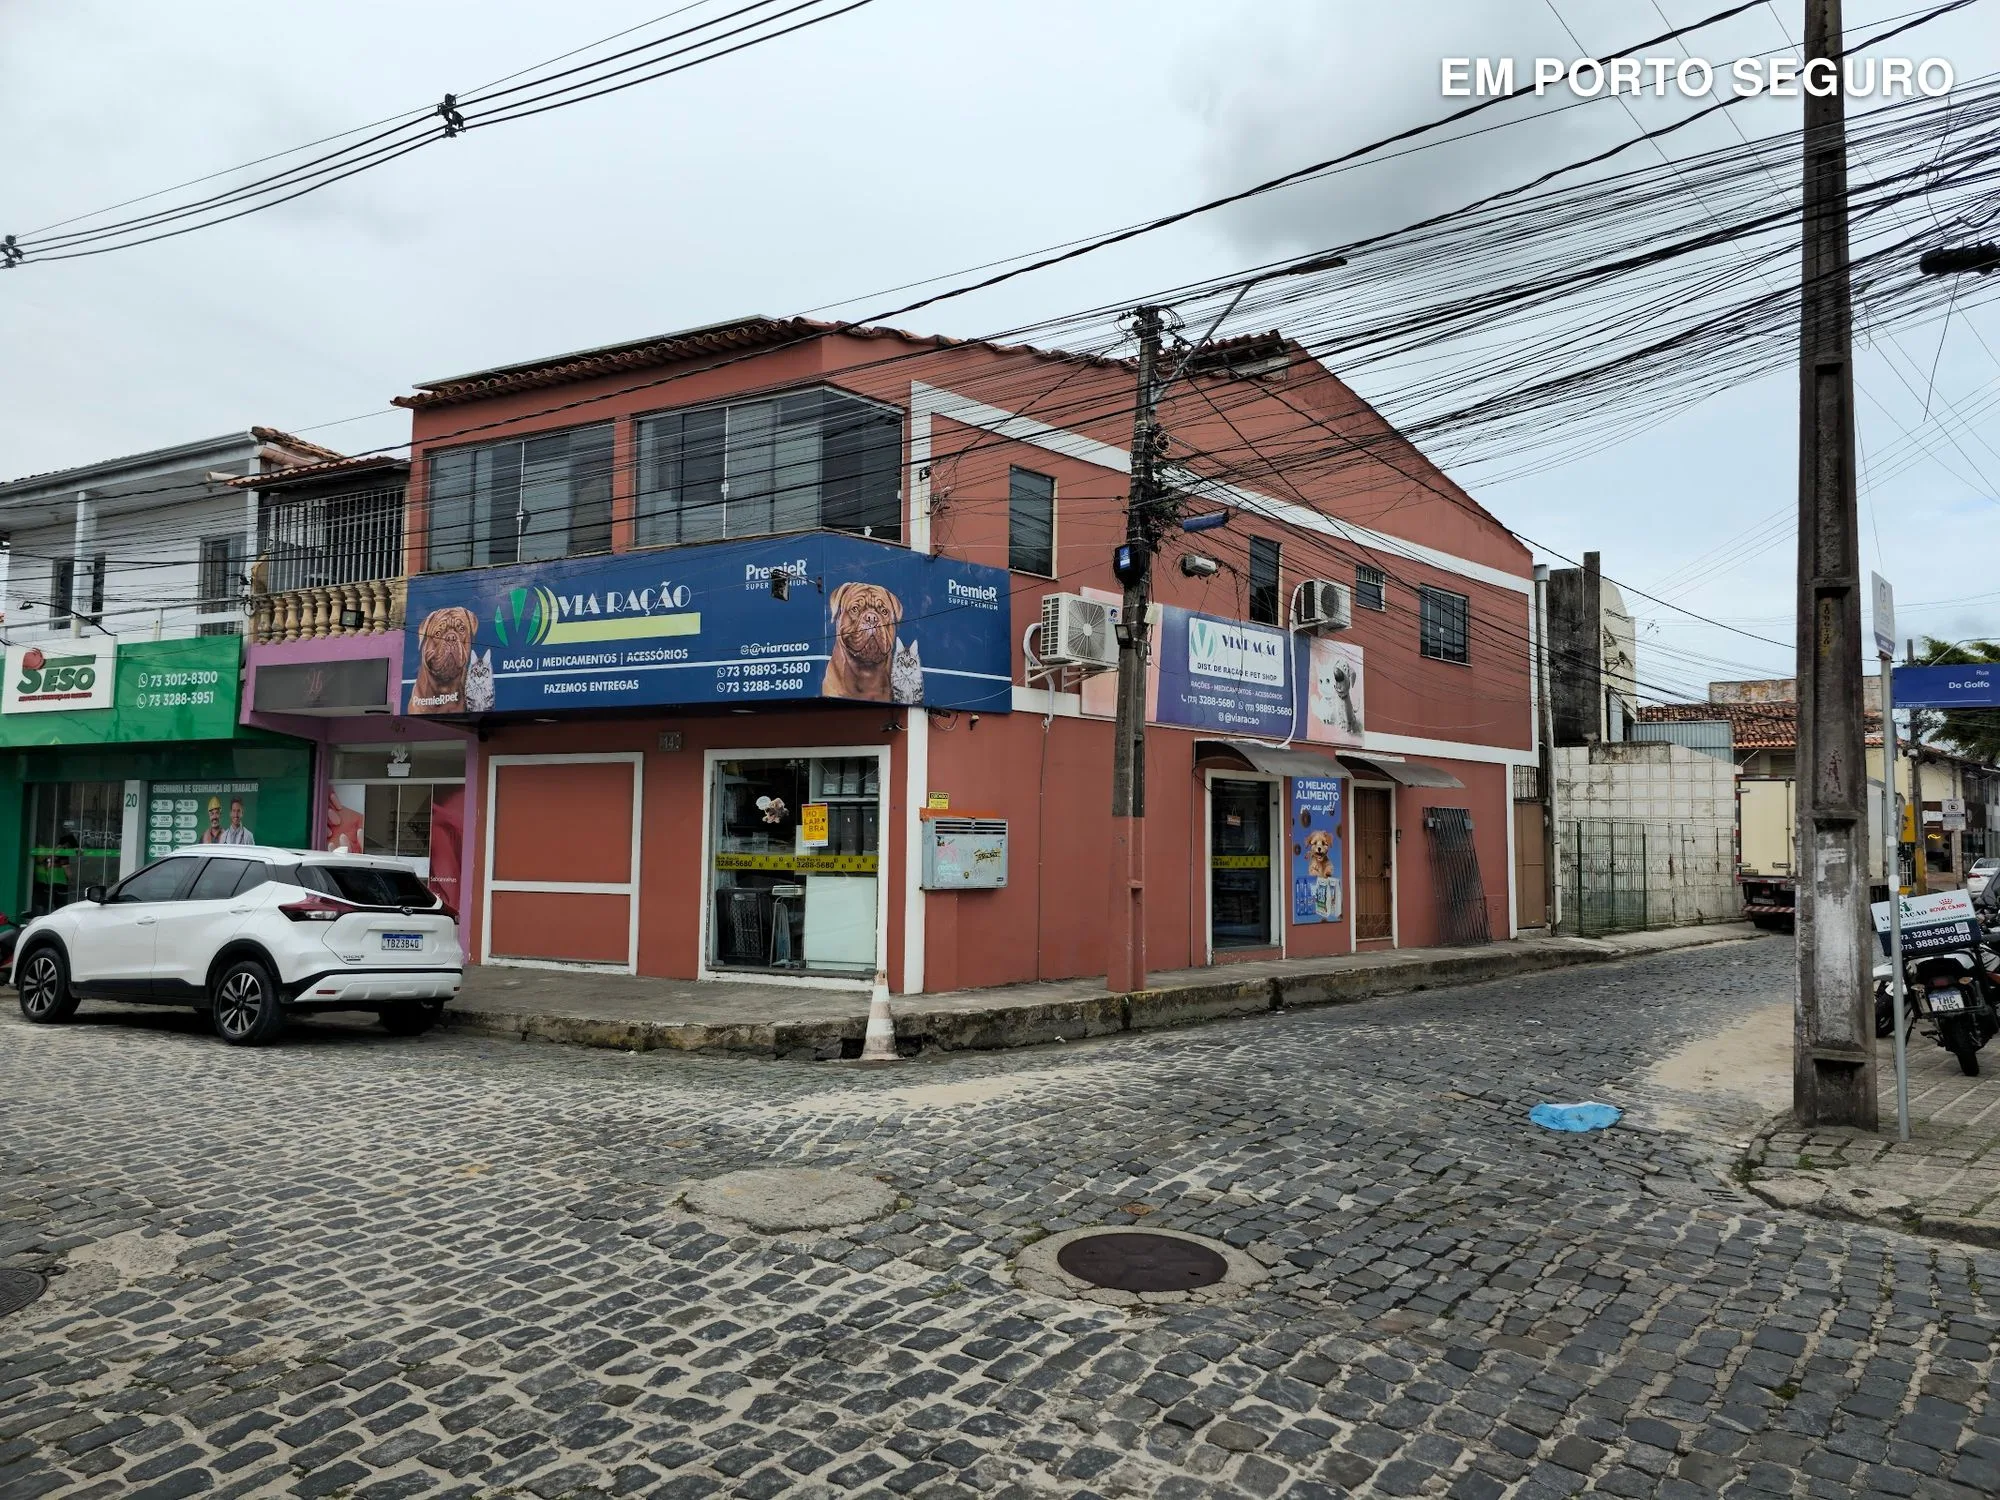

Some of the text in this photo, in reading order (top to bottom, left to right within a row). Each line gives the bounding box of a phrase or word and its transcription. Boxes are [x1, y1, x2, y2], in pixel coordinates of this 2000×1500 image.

[745, 559, 807, 580] PreieR
[745, 582, 769, 590] SUPER
[948, 578, 998, 602] PremieR
[557, 580, 692, 617] VIA RAÇÃO
[948, 597, 998, 610] SUPER PREMIUM
[749, 641, 810, 656] @viaracao
[502, 648, 689, 672] RAÇÃO MEDICAMENTOS ACESSÓRIOS
[726, 662, 811, 678] 73 98893-5680
[1197, 662, 1212, 671] DIST.
[1250, 671, 1261, 679] PET
[17, 663, 96, 694] SESO
[150, 671, 218, 688] 73 3012-8300
[726, 679, 803, 693] 73 3288-5680
[1190, 680, 1211, 690] RAÇÕES
[1964, 680, 1990, 689] Golfo
[543, 679, 640, 694] FAZEMOS ENTREGAS
[149, 691, 215, 708] 73 3288-3951
[1198, 695, 1236, 709] 3288-5680
[1255, 703, 1293, 717] 98893-5680
[1224, 712, 1260, 725] @viaracao
[1297, 780, 1337, 791] O MELHOR
[125, 793, 138, 808] 20
[1295, 790, 1340, 801] ALIMENTO
[1911, 926, 1956, 939] 3288-5680
[1915, 933, 1972, 949] 98893-5680
